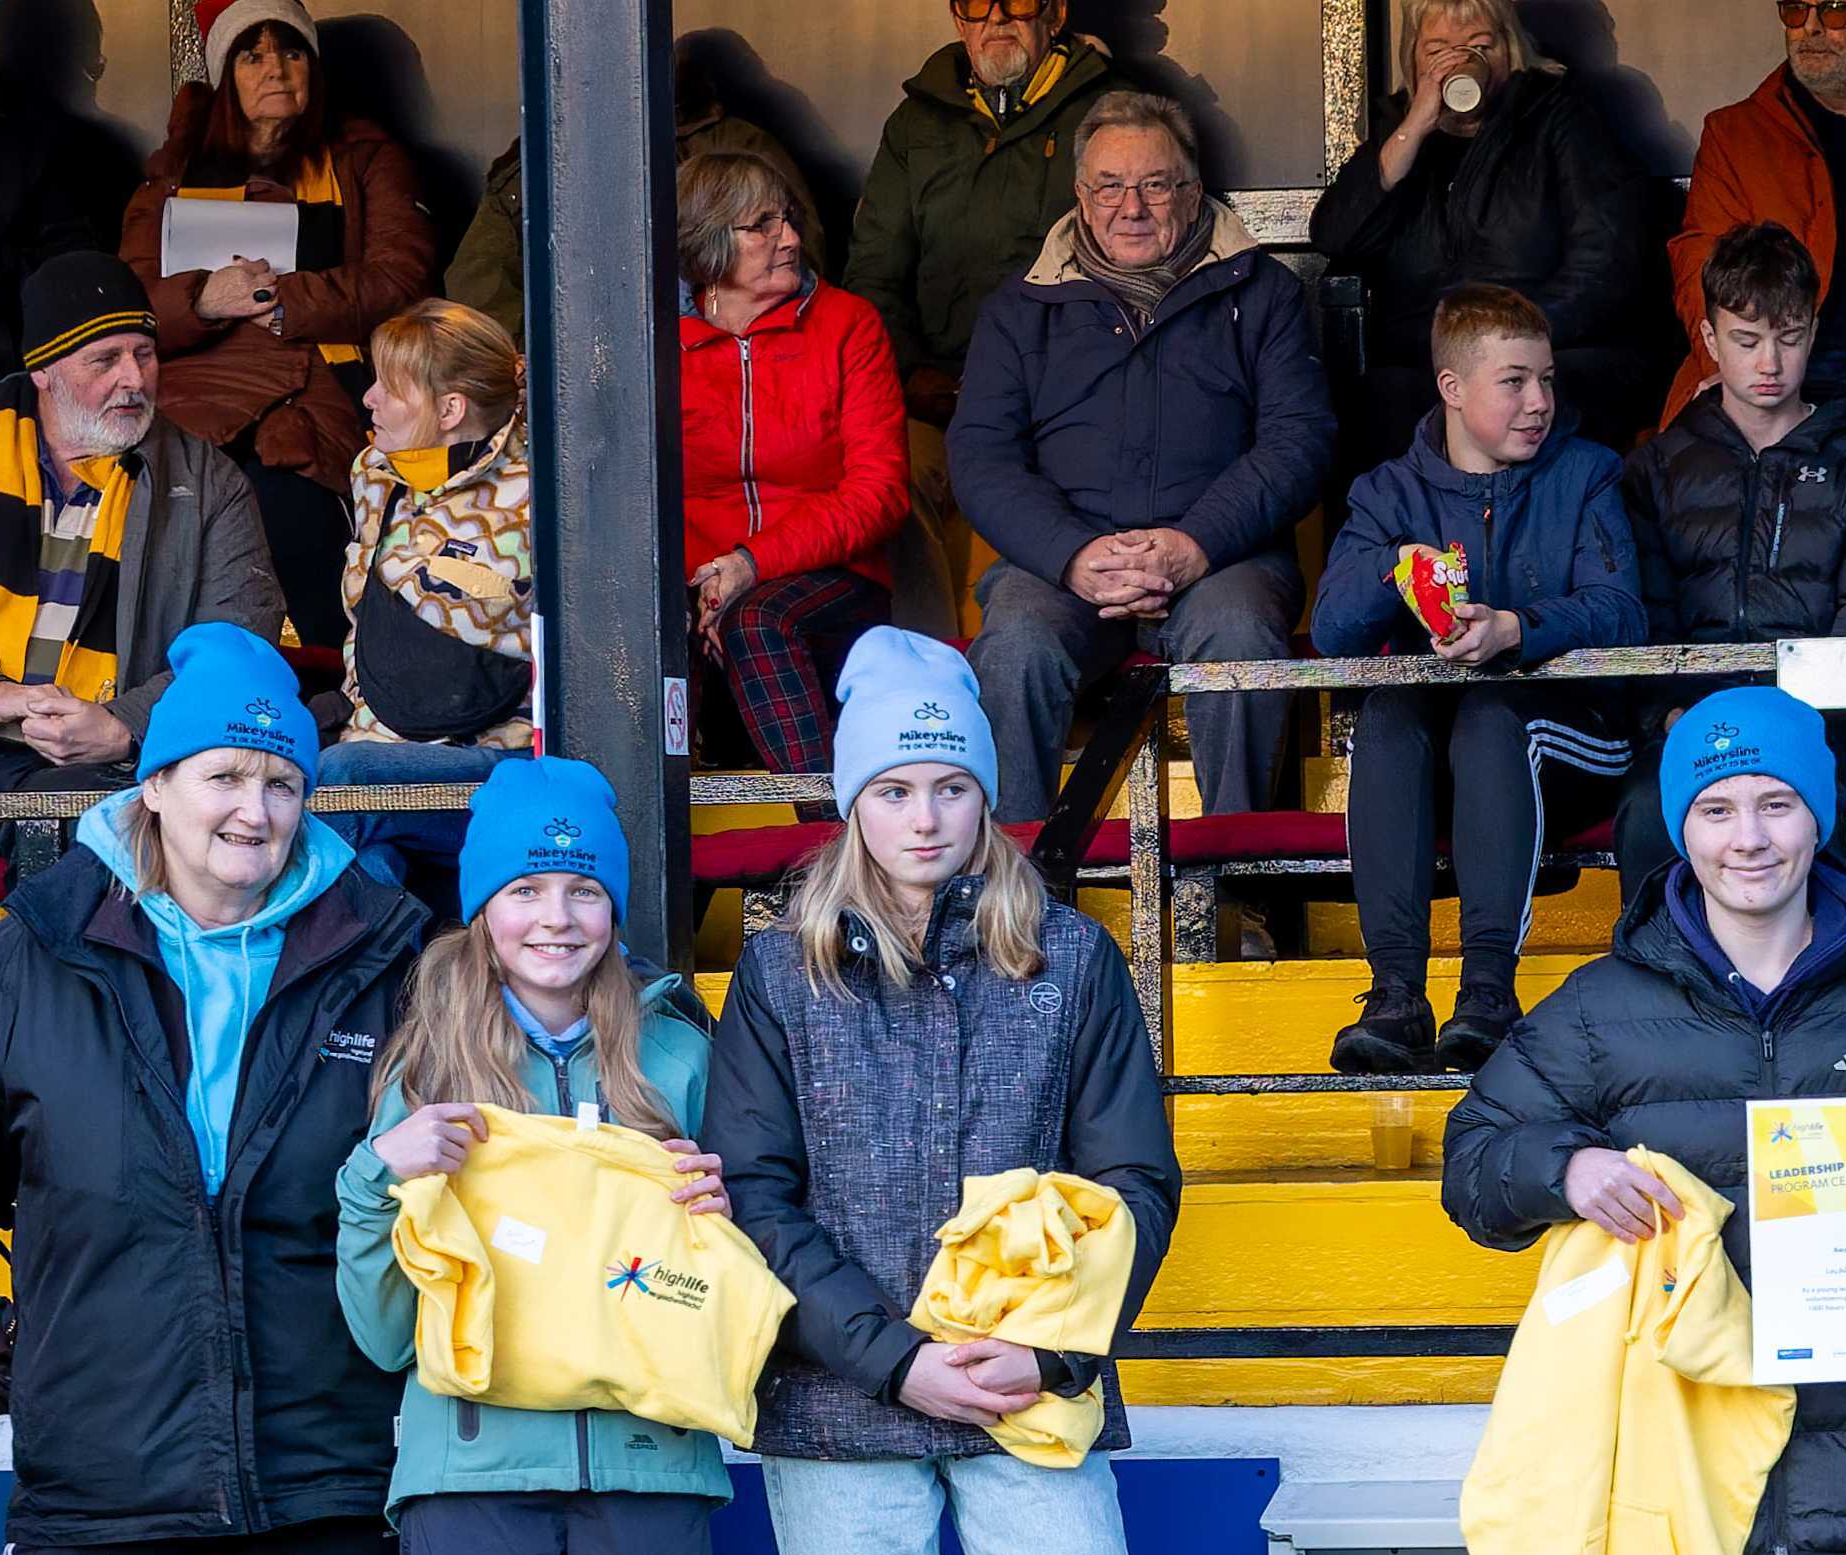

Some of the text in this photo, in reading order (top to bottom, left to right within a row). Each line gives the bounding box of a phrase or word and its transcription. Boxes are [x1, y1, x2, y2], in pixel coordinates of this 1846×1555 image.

[227, 722, 296, 746] Mikeysline
[899, 730, 966, 744] Mikeysline
[330, 1030, 375, 1047] highlife
[1769, 1161, 1844, 1179] LEADERSHIP
[1770, 1179, 1830, 1194] PROGRAM
[653, 1265, 710, 1294] highlife
